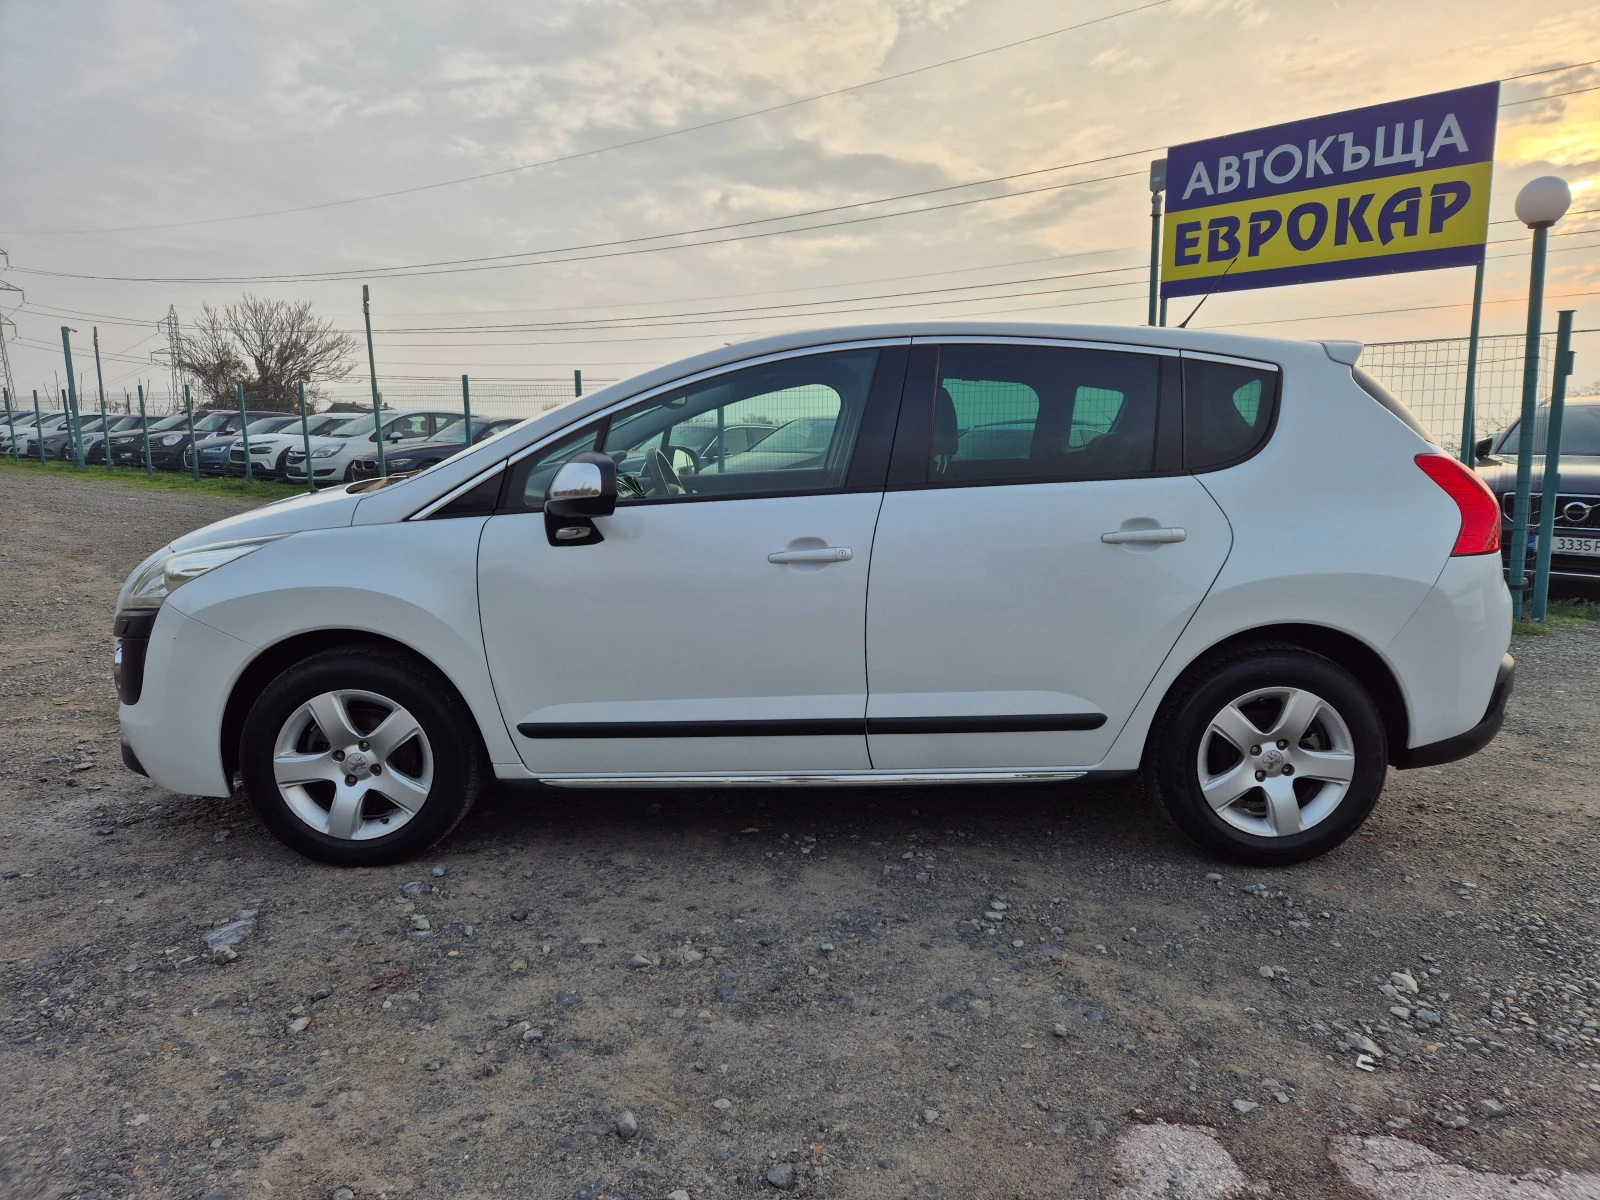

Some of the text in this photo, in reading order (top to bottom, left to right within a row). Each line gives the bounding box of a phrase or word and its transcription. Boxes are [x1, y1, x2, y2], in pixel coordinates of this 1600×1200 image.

[1182, 113, 1469, 200] АВТОКЪЩА
[1174, 181, 1471, 267] ЕВРОКАР
[1557, 538, 1592, 552] 3335
